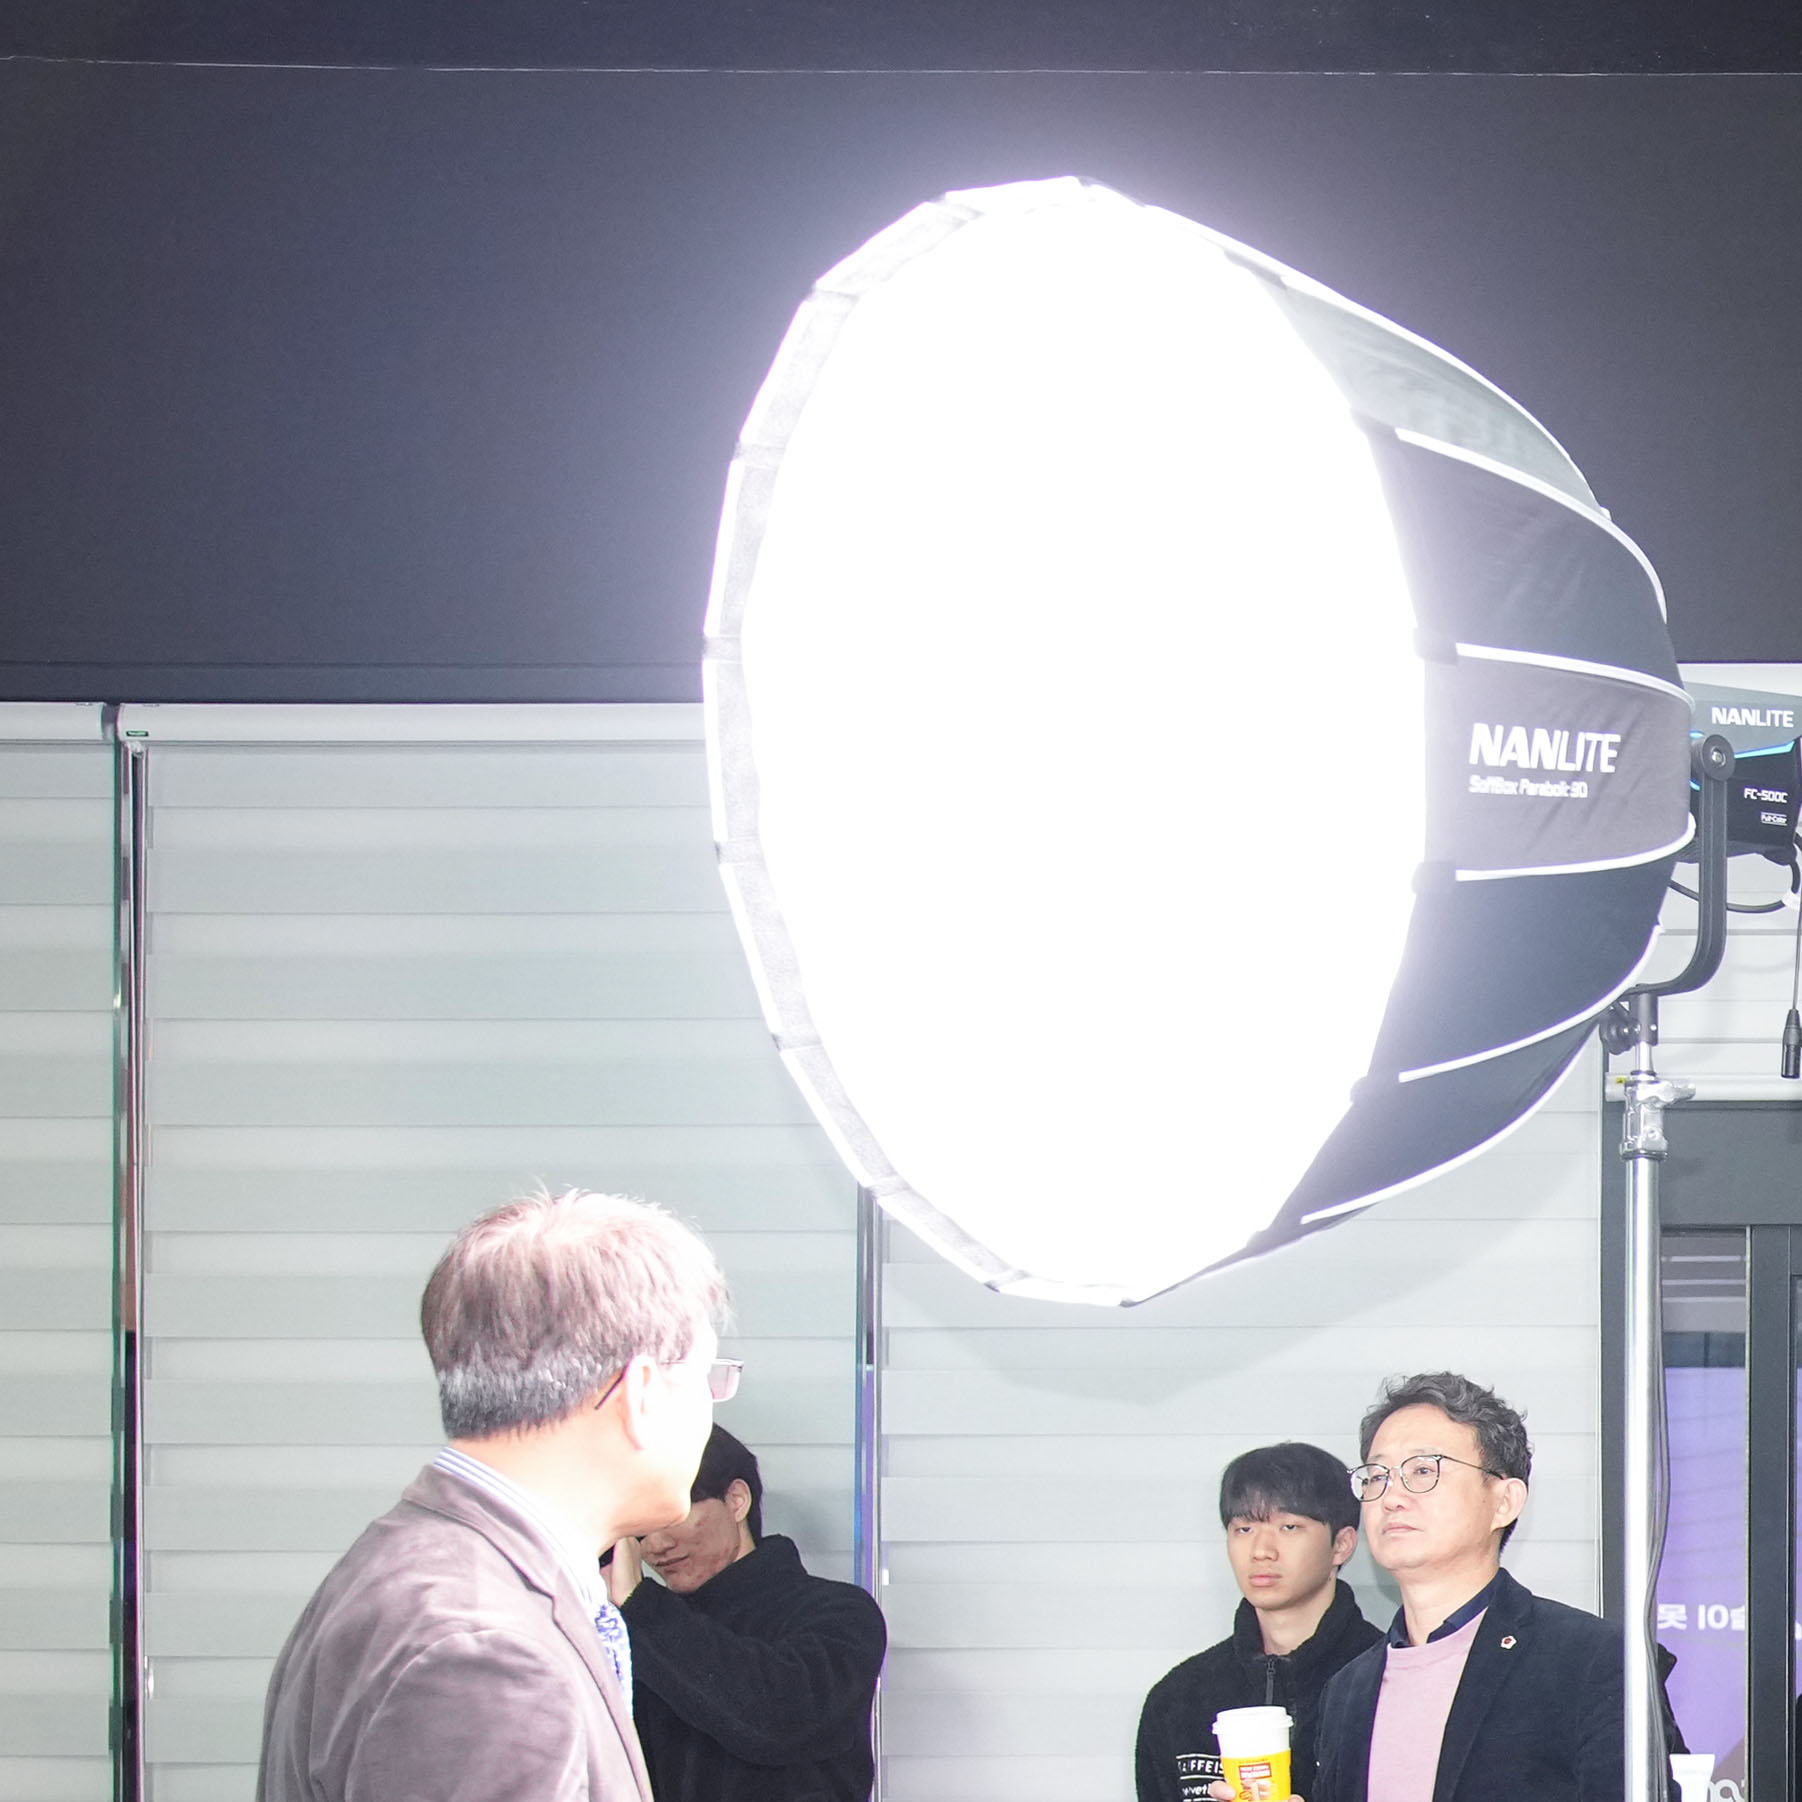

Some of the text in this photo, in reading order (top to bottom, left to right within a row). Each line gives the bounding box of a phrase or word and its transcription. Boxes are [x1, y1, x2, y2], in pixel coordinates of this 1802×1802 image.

[1711, 707, 1795, 728] NANLITE
[1469, 722, 1622, 773] NANLITE
[1743, 787, 1788, 804] FC-500C
